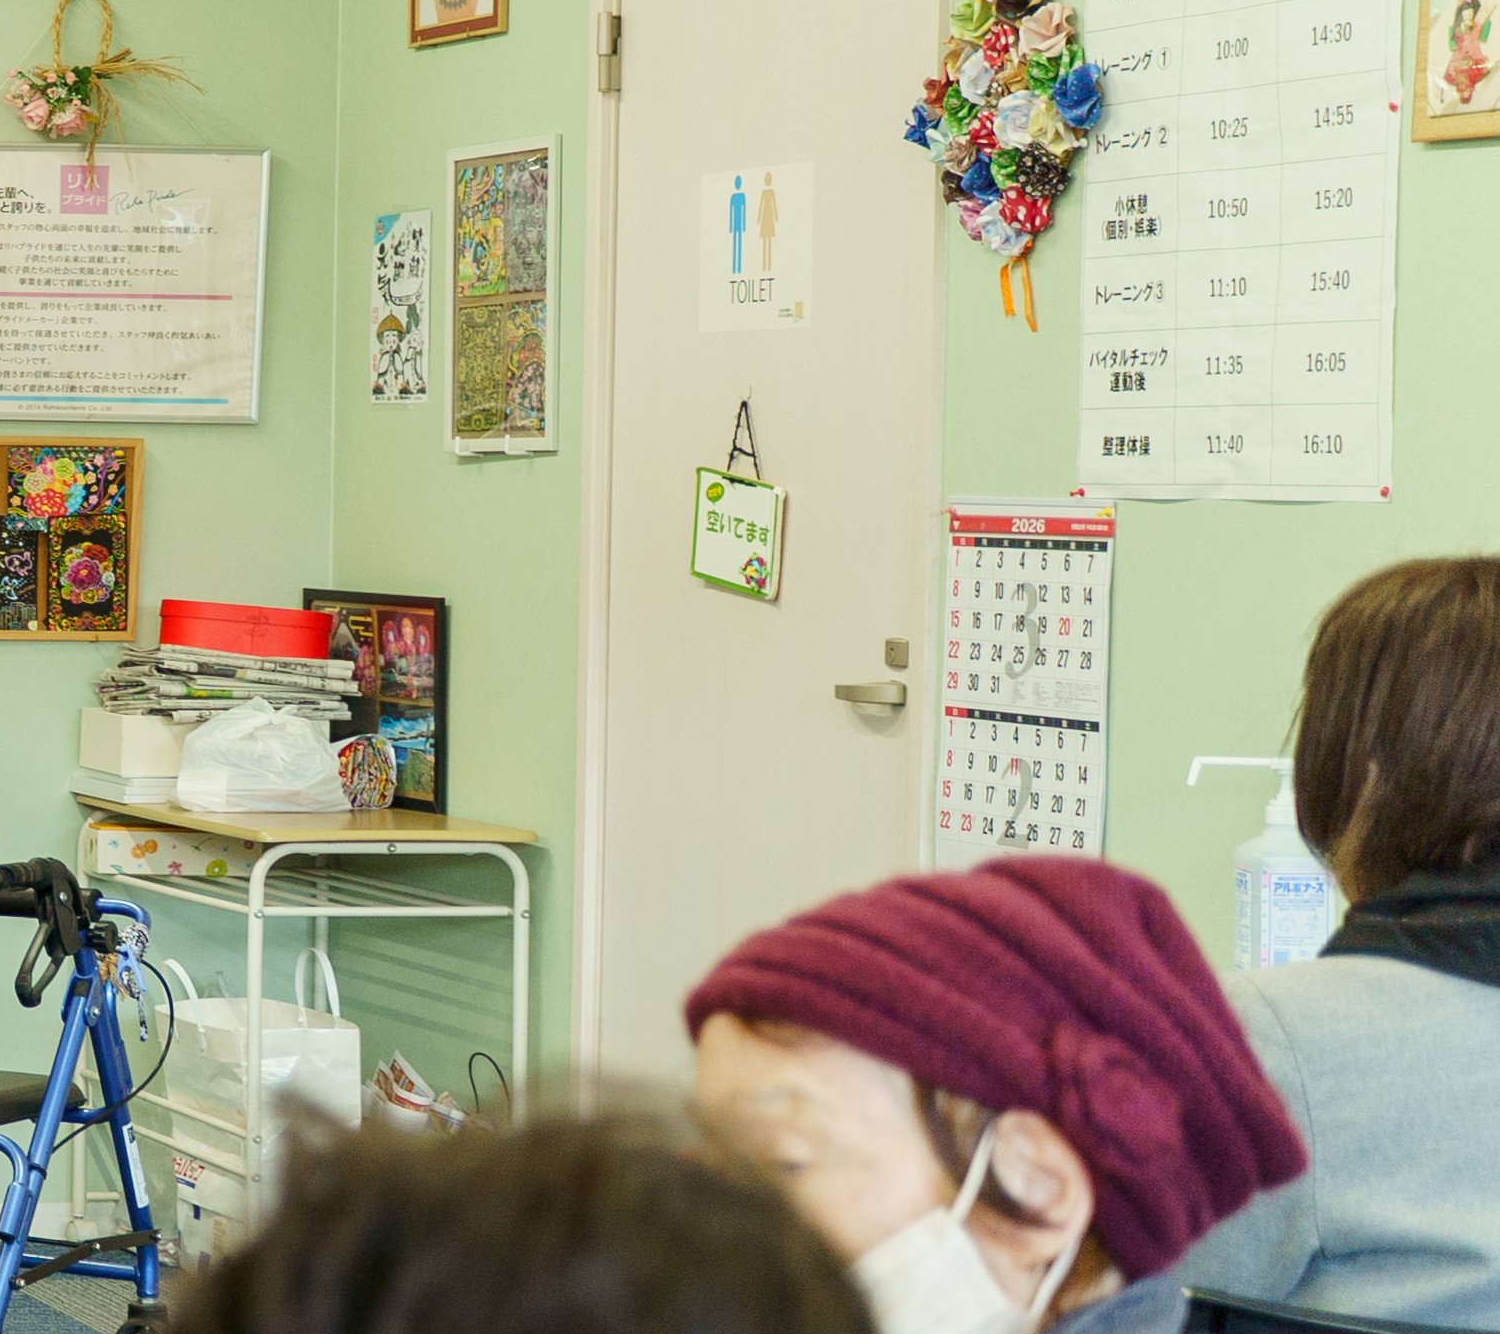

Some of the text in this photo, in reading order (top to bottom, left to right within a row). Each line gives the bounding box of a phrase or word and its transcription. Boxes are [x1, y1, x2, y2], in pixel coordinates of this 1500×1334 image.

[1215, 36, 1250, 62] 10:00
[1311, 21, 1353, 47] 14:30
[1210, 117, 1249, 141] 10:25
[1313, 104, 1355, 129] 14:55
[62, 194, 107, 205] プライド
[1114, 186, 1354, 220] 小休憩 10:50 15:20
[729, 278, 775, 304] TOILET
[1209, 276, 1248, 299] 11:10
[1310, 269, 1351, 293] 15:40
[1089, 346, 1347, 377] バイタルチェック 11:35 16:05
[1109, 370, 1147, 394] 運動後
[1101, 433, 1344, 458] 整理体操 11:40 16:10
[706, 509, 769, 546] 空いてます
[1011, 518, 1045, 533] 2026
[955, 550, 1094, 573] 1 2 3 4 5 6 7
[953, 580, 1092, 605] 8 9 10 11 12 13 14
